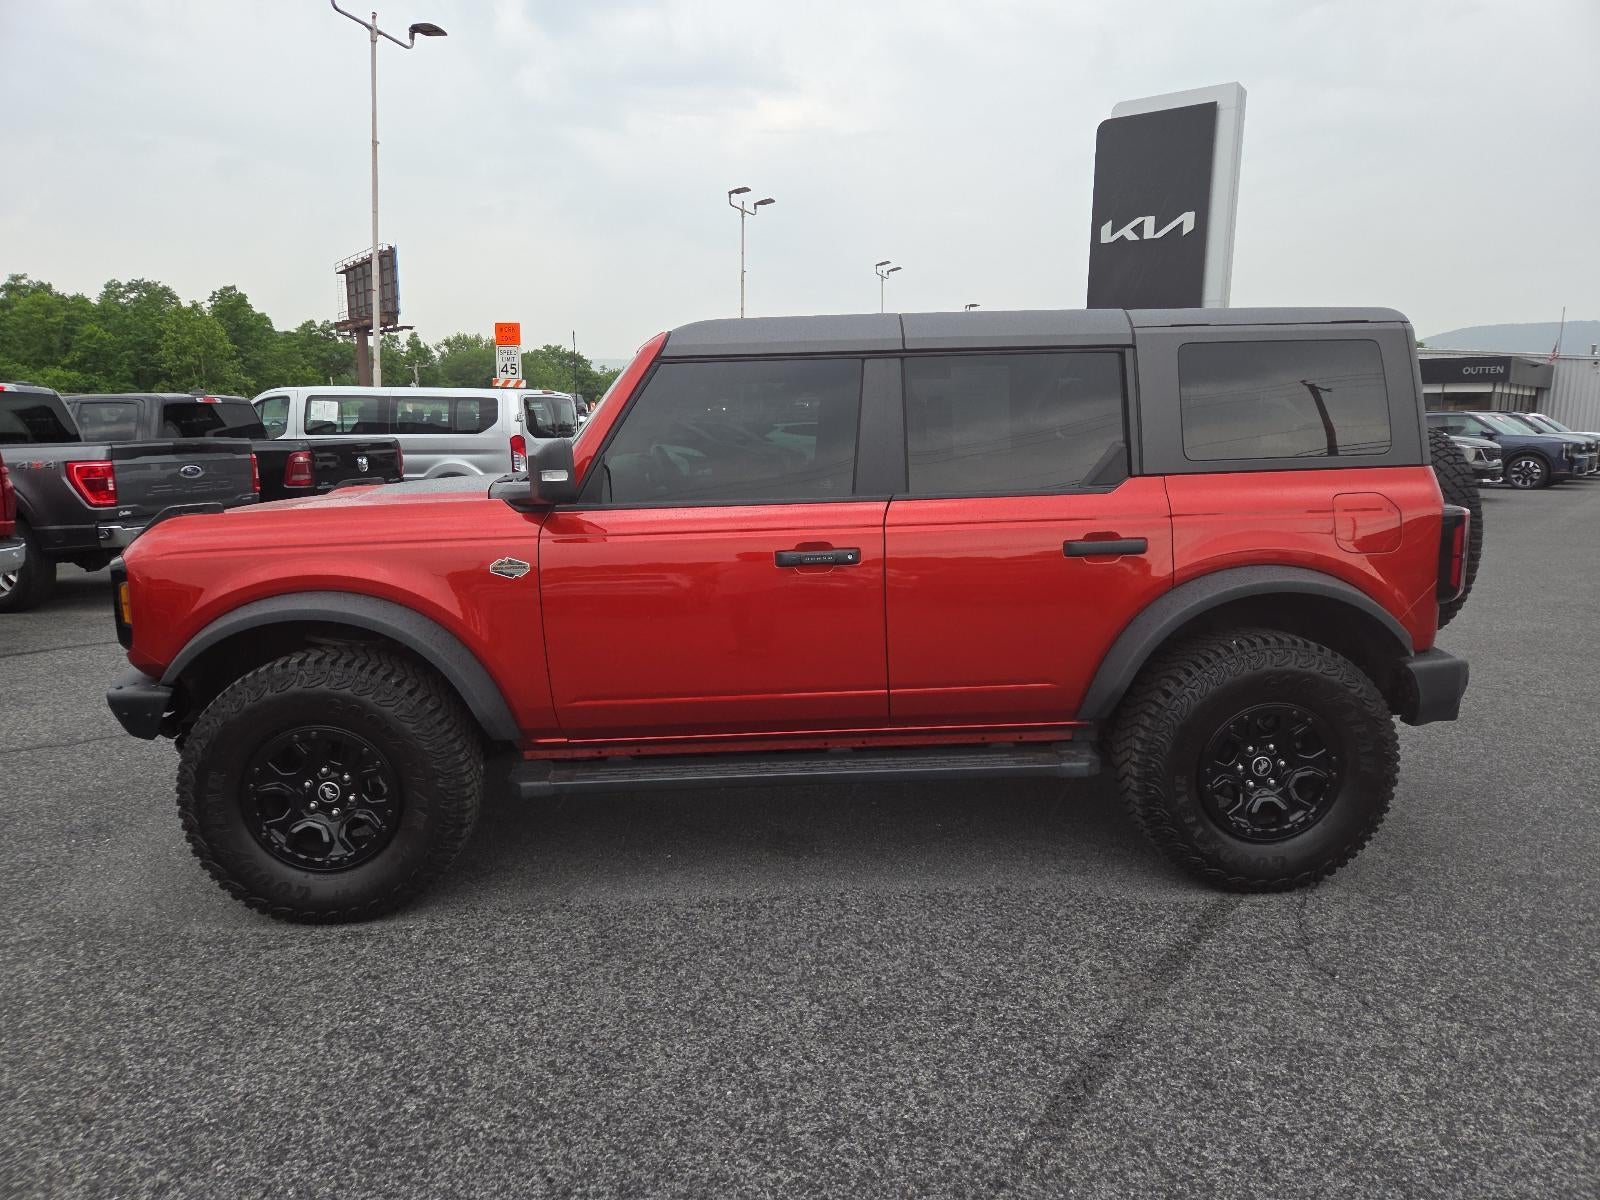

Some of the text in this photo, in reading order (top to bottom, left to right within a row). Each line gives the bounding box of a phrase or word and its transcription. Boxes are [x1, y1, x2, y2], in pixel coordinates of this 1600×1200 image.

[1100, 211, 1196, 244] KIA
[500, 363, 518, 375] 45
[1462, 365, 1505, 375] OUTTEN
